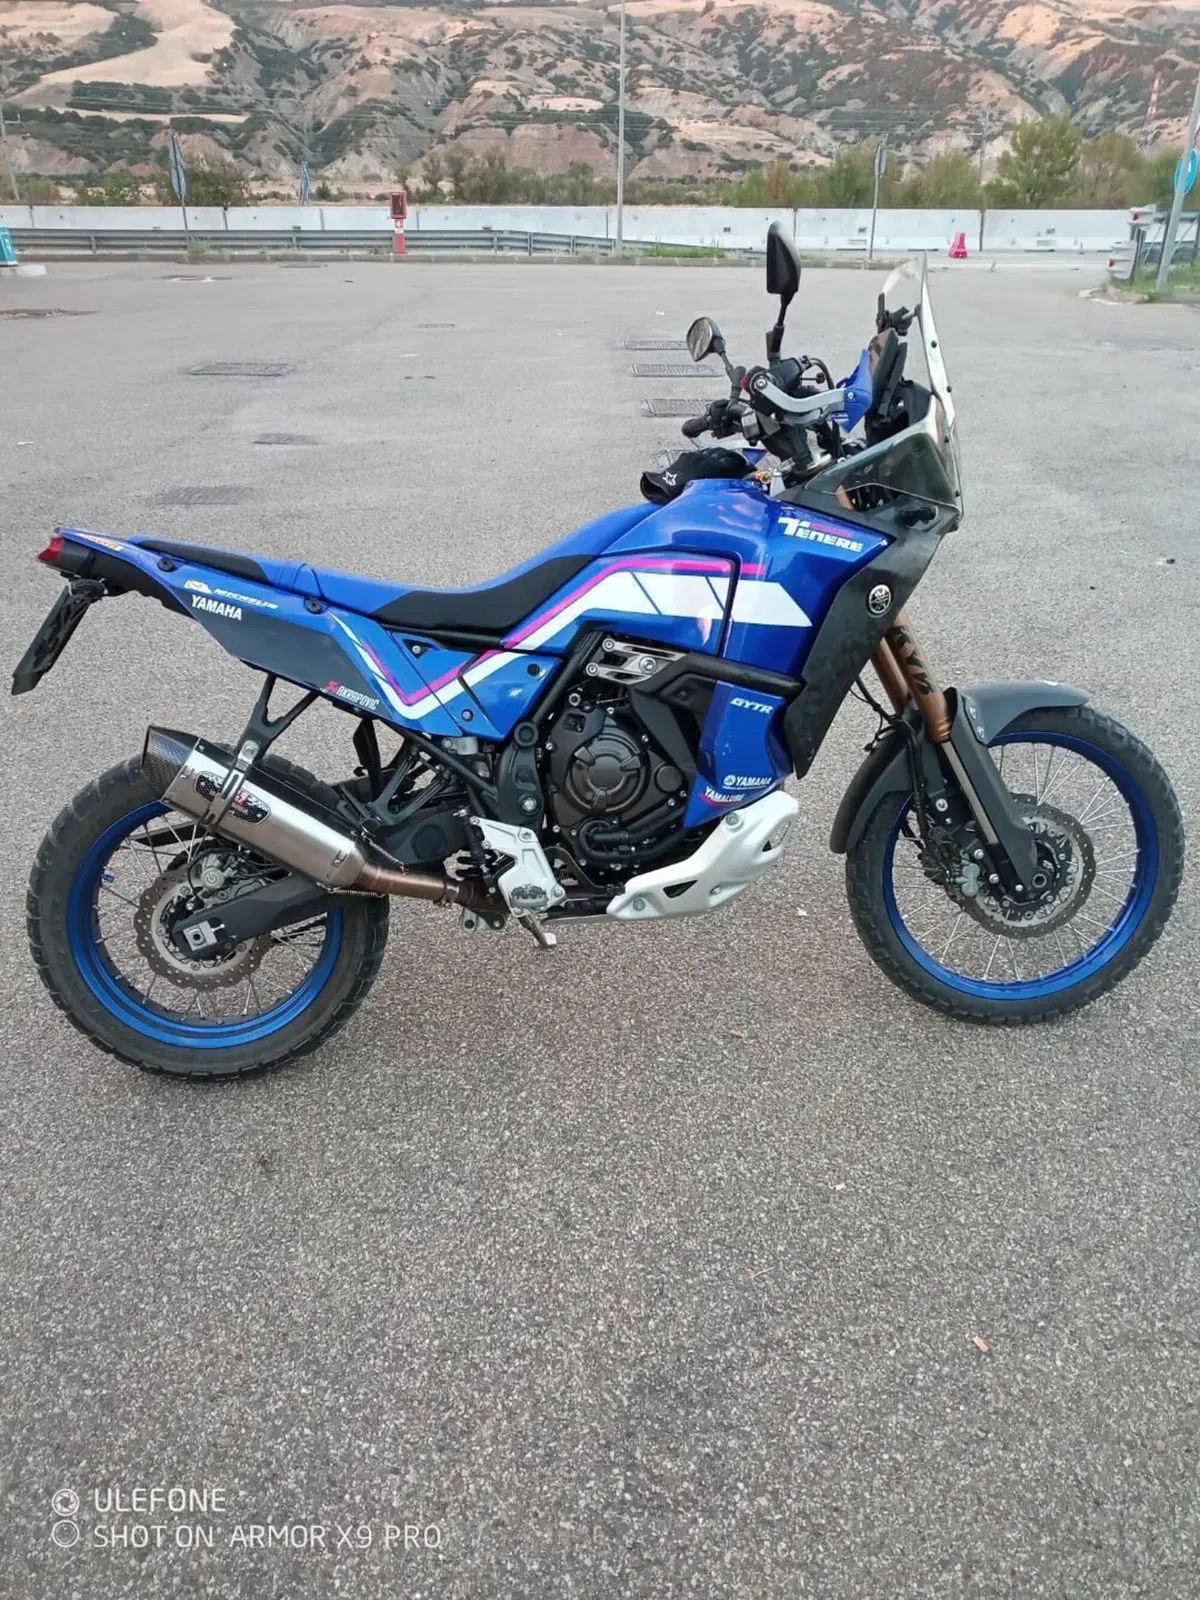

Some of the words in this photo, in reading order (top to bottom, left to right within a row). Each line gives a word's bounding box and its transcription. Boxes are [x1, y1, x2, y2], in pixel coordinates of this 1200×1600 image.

[191, 594, 243, 621] YAMAHA
[213, 588, 279, 610] MICHELIN
[730, 697, 774, 714] GYTR
[736, 776, 773, 787] YAMAHA
[703, 786, 746, 803] YAMALUBE
